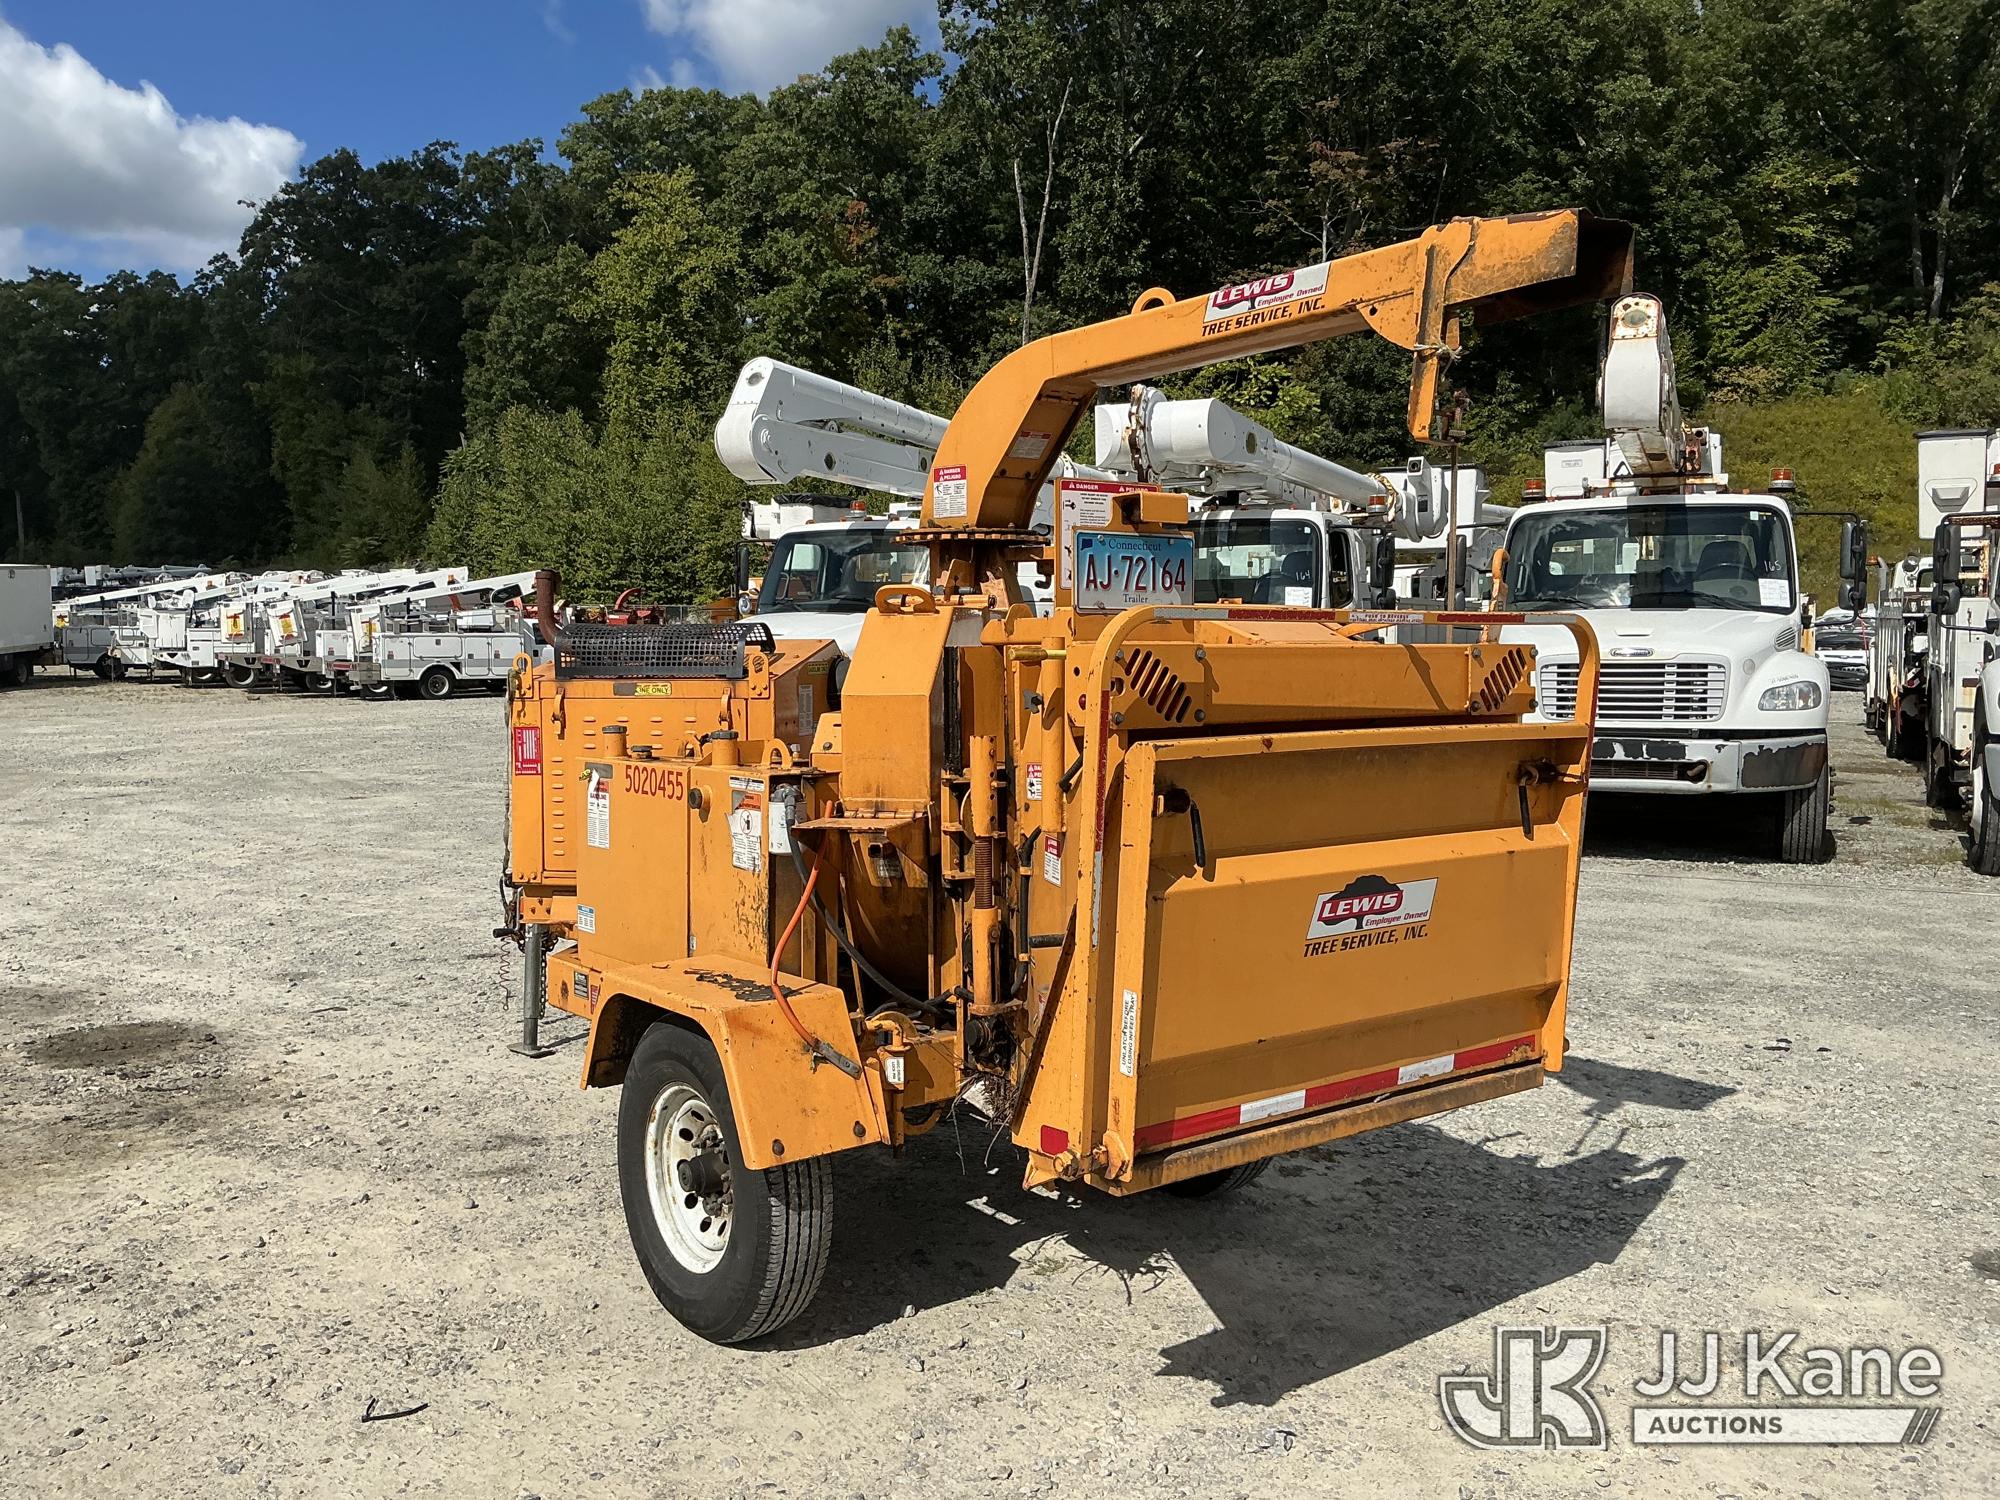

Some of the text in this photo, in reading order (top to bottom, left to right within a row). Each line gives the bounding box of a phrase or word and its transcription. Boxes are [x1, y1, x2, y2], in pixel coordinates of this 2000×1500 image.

[1216, 273, 1289, 304] LEWIS
[1257, 284, 1324, 307] Employee Owned
[1202, 297, 1326, 337] TREE SERVICE, INC.
[1075, 483, 1099, 491] DANGER
[1108, 539, 1162, 552] Connecticut
[1122, 593, 1149, 604] Trailer
[625, 764, 684, 801] 5020455
[1321, 893, 1399, 919] LEWIS
[1364, 909, 1429, 927] Employee Owned
[1303, 924, 1429, 958] TREE SERVICE, INC.
